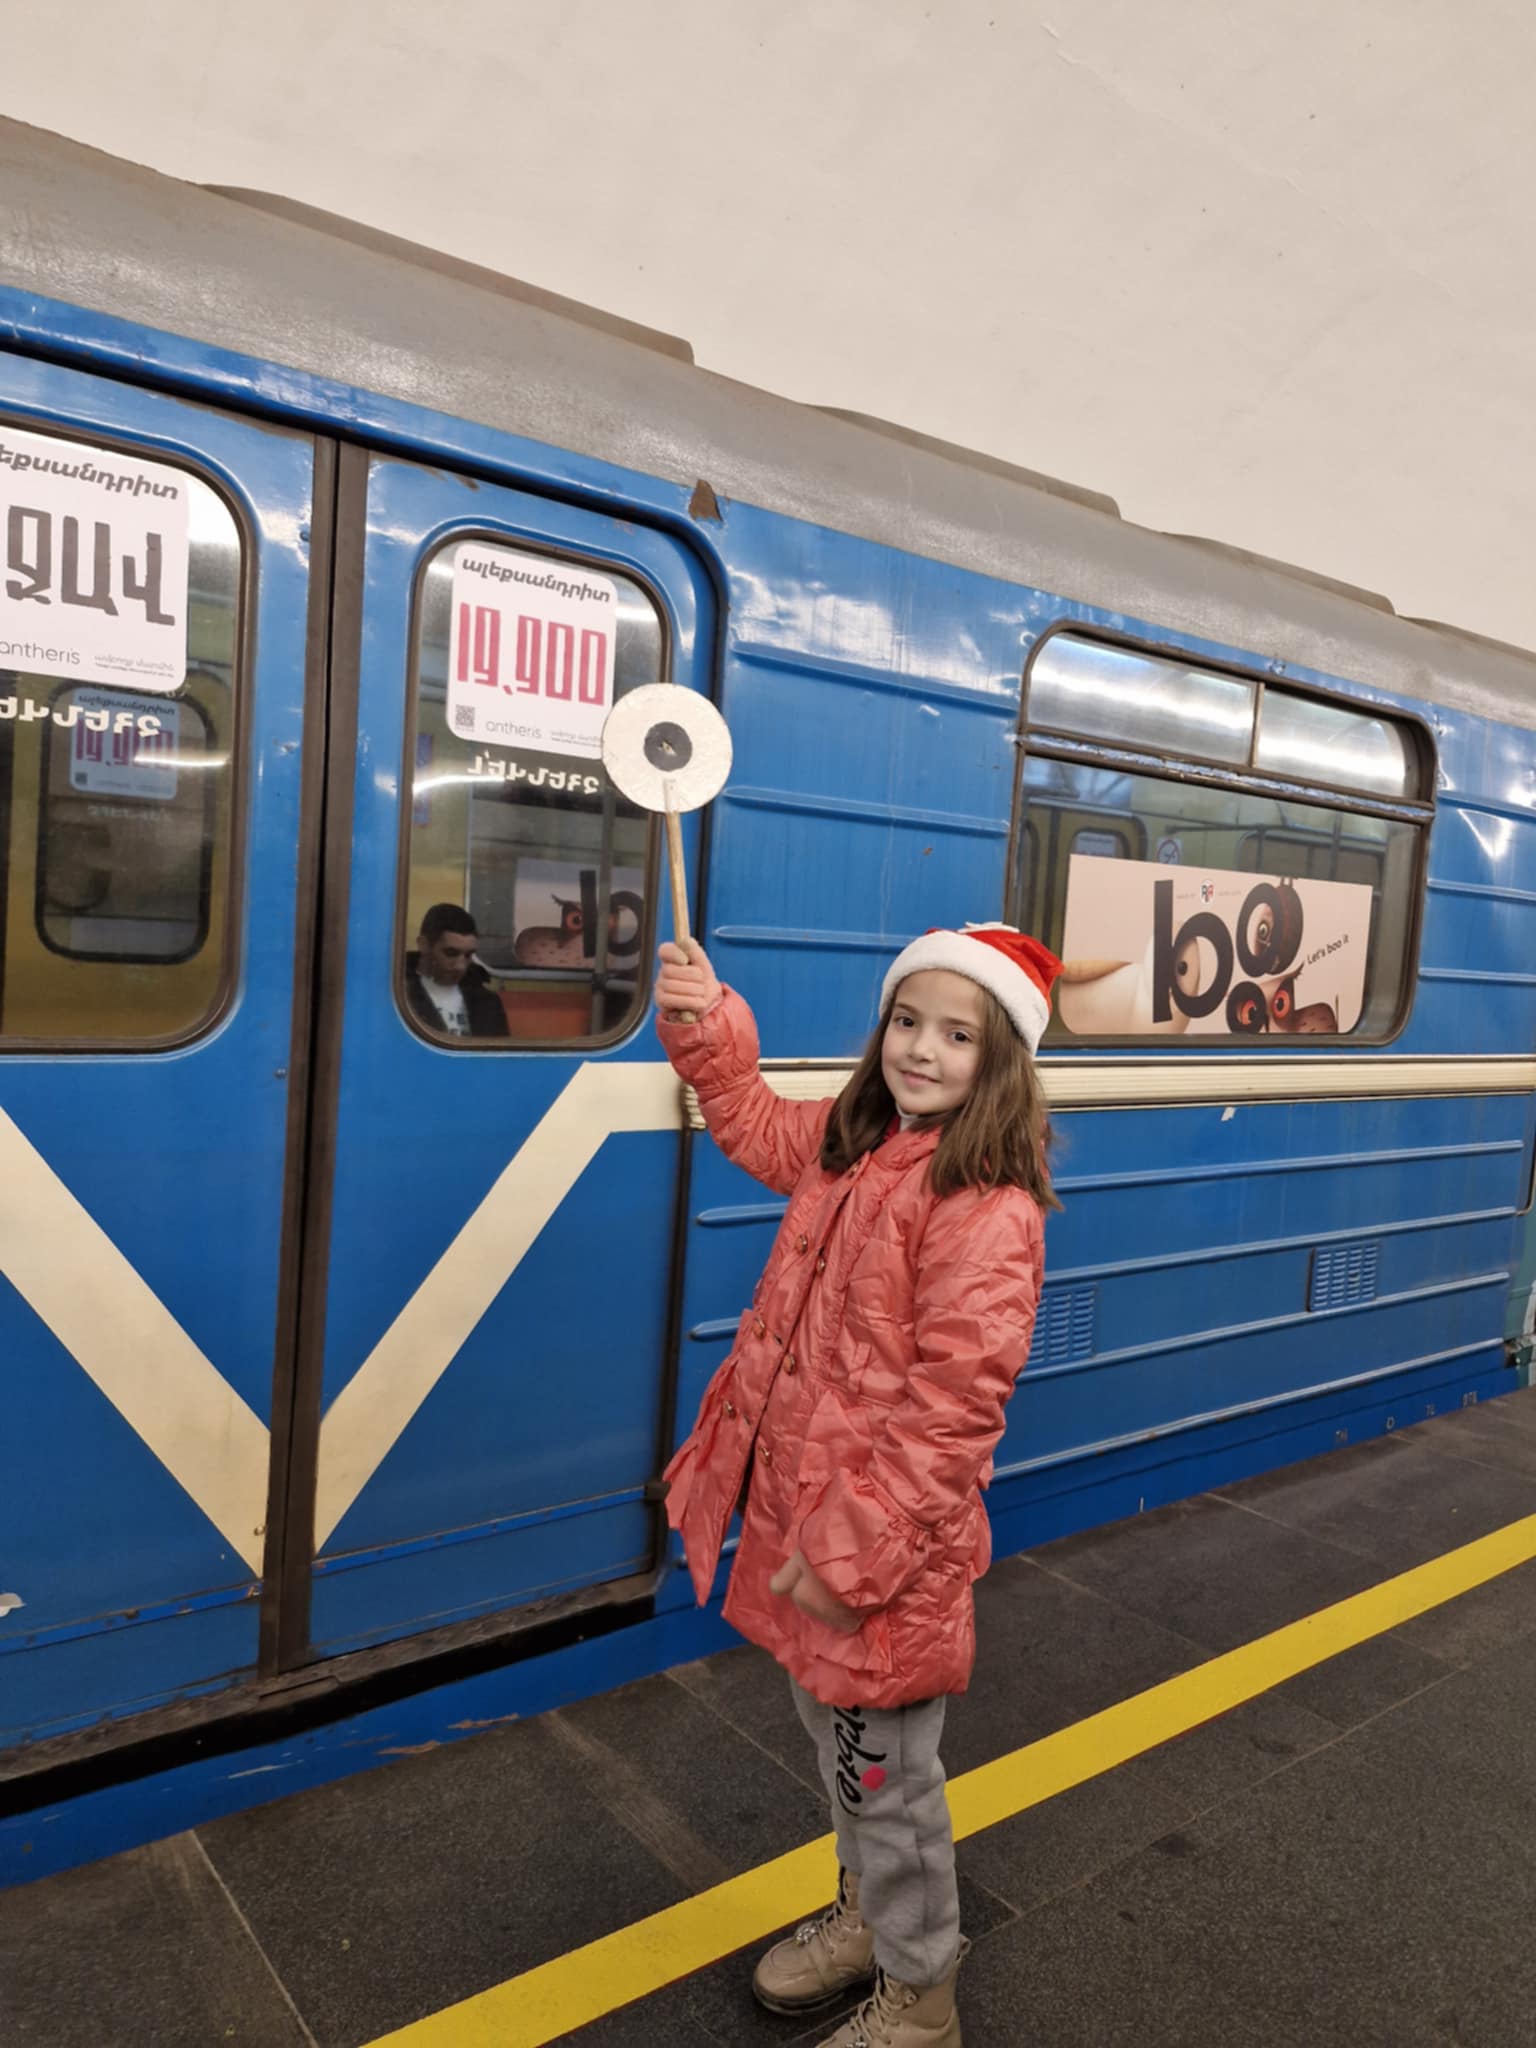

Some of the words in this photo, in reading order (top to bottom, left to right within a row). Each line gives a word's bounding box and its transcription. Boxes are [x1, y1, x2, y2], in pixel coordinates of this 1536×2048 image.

[462, 558, 611, 603] ալեքսանդրիտ
[1306, 948, 1327, 964] Let's
[1326, 939, 1342, 954] boo
[1342, 933, 1350, 944] it
